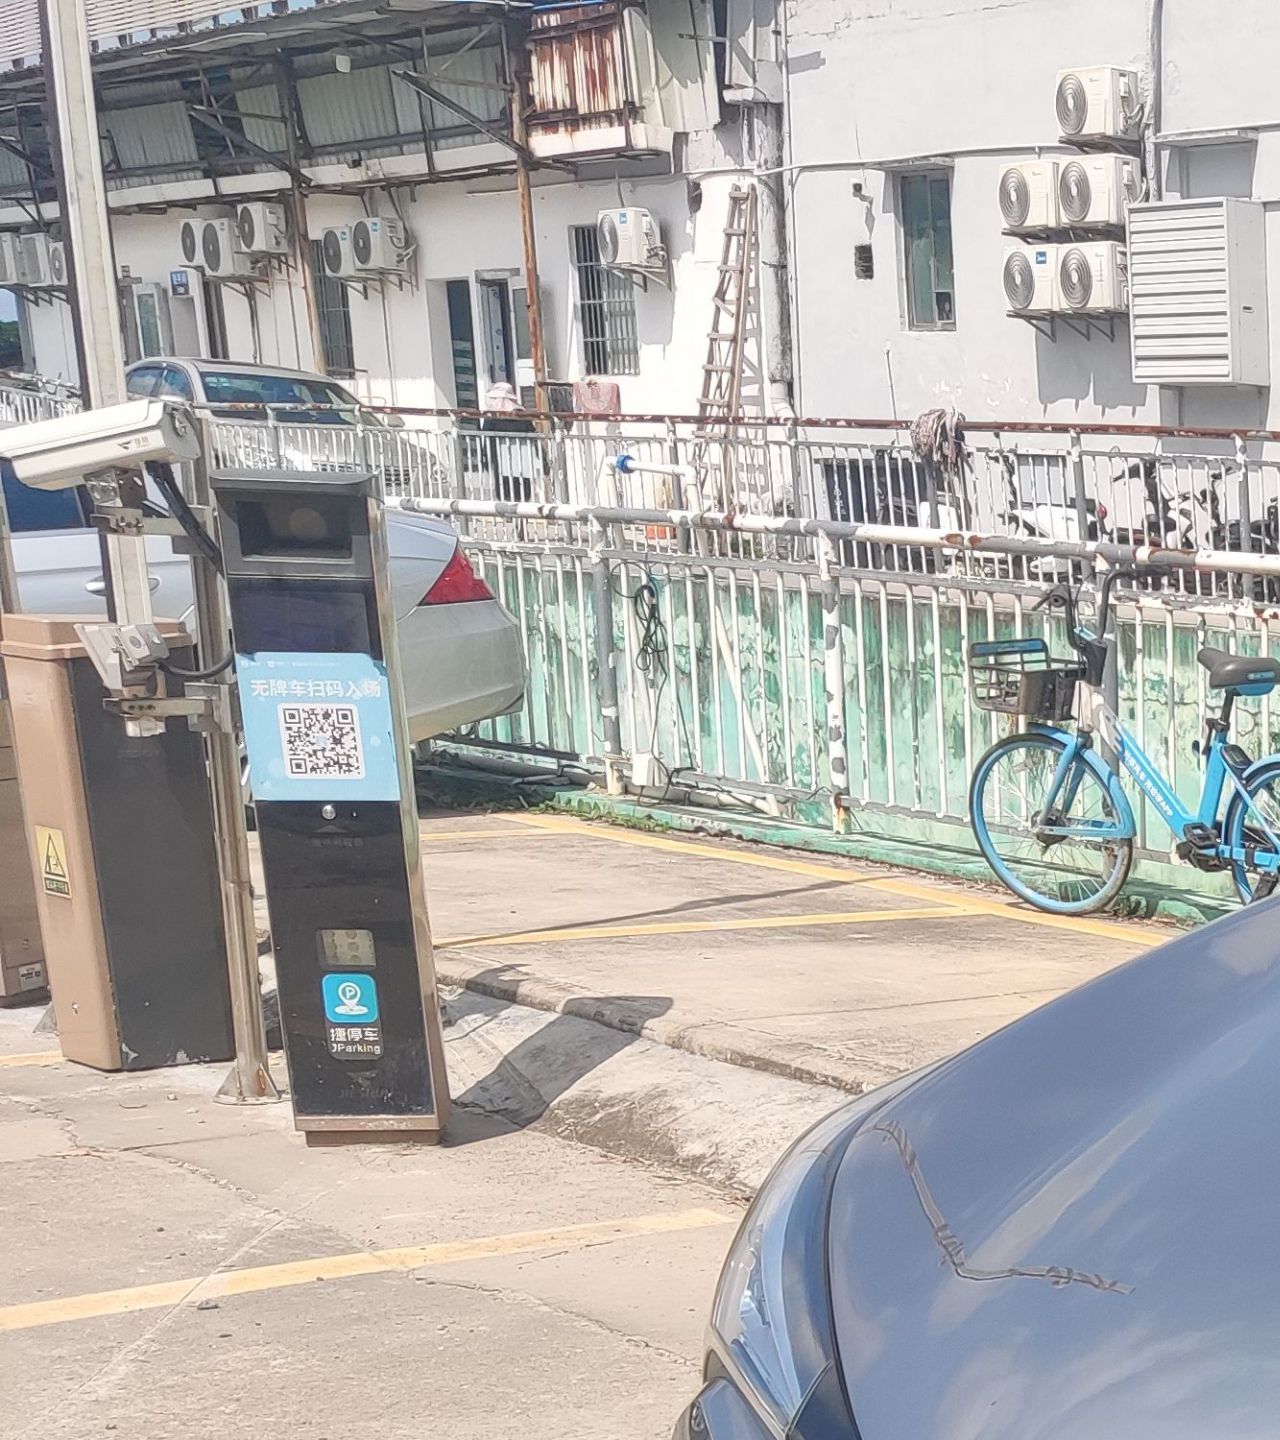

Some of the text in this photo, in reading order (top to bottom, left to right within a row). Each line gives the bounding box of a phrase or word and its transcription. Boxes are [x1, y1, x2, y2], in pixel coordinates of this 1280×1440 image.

[251, 678, 381, 698] 无牌车扫码入场
[331, 1043, 381, 1054] JParking
